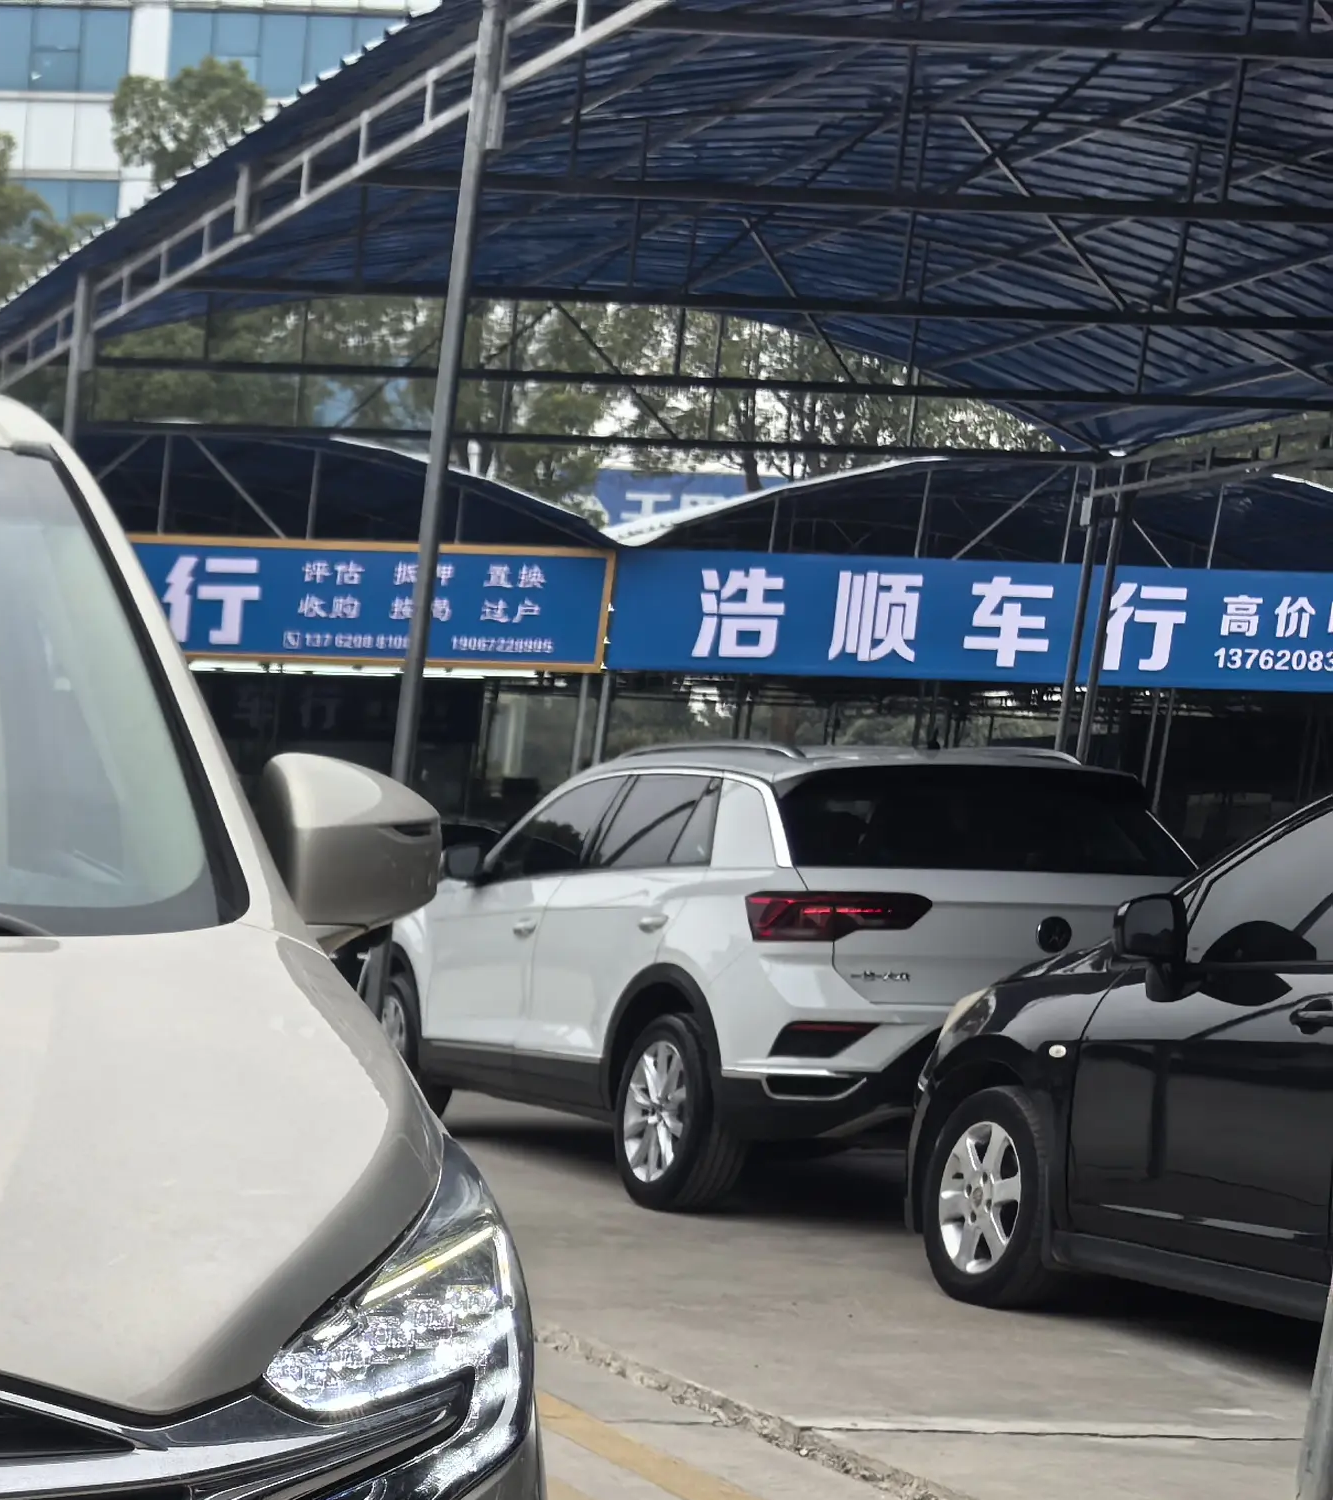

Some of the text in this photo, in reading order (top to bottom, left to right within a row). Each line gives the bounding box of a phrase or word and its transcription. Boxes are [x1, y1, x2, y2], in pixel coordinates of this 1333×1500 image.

[302, 560, 365, 586] 评估
[483, 564, 547, 589] 置换
[161, 556, 262, 645] 行
[297, 594, 361, 619] 收购
[479, 598, 542, 624] 过户
[690, 567, 1188, 672] 浩顺车行
[1219, 594, 1333, 639] 高价
